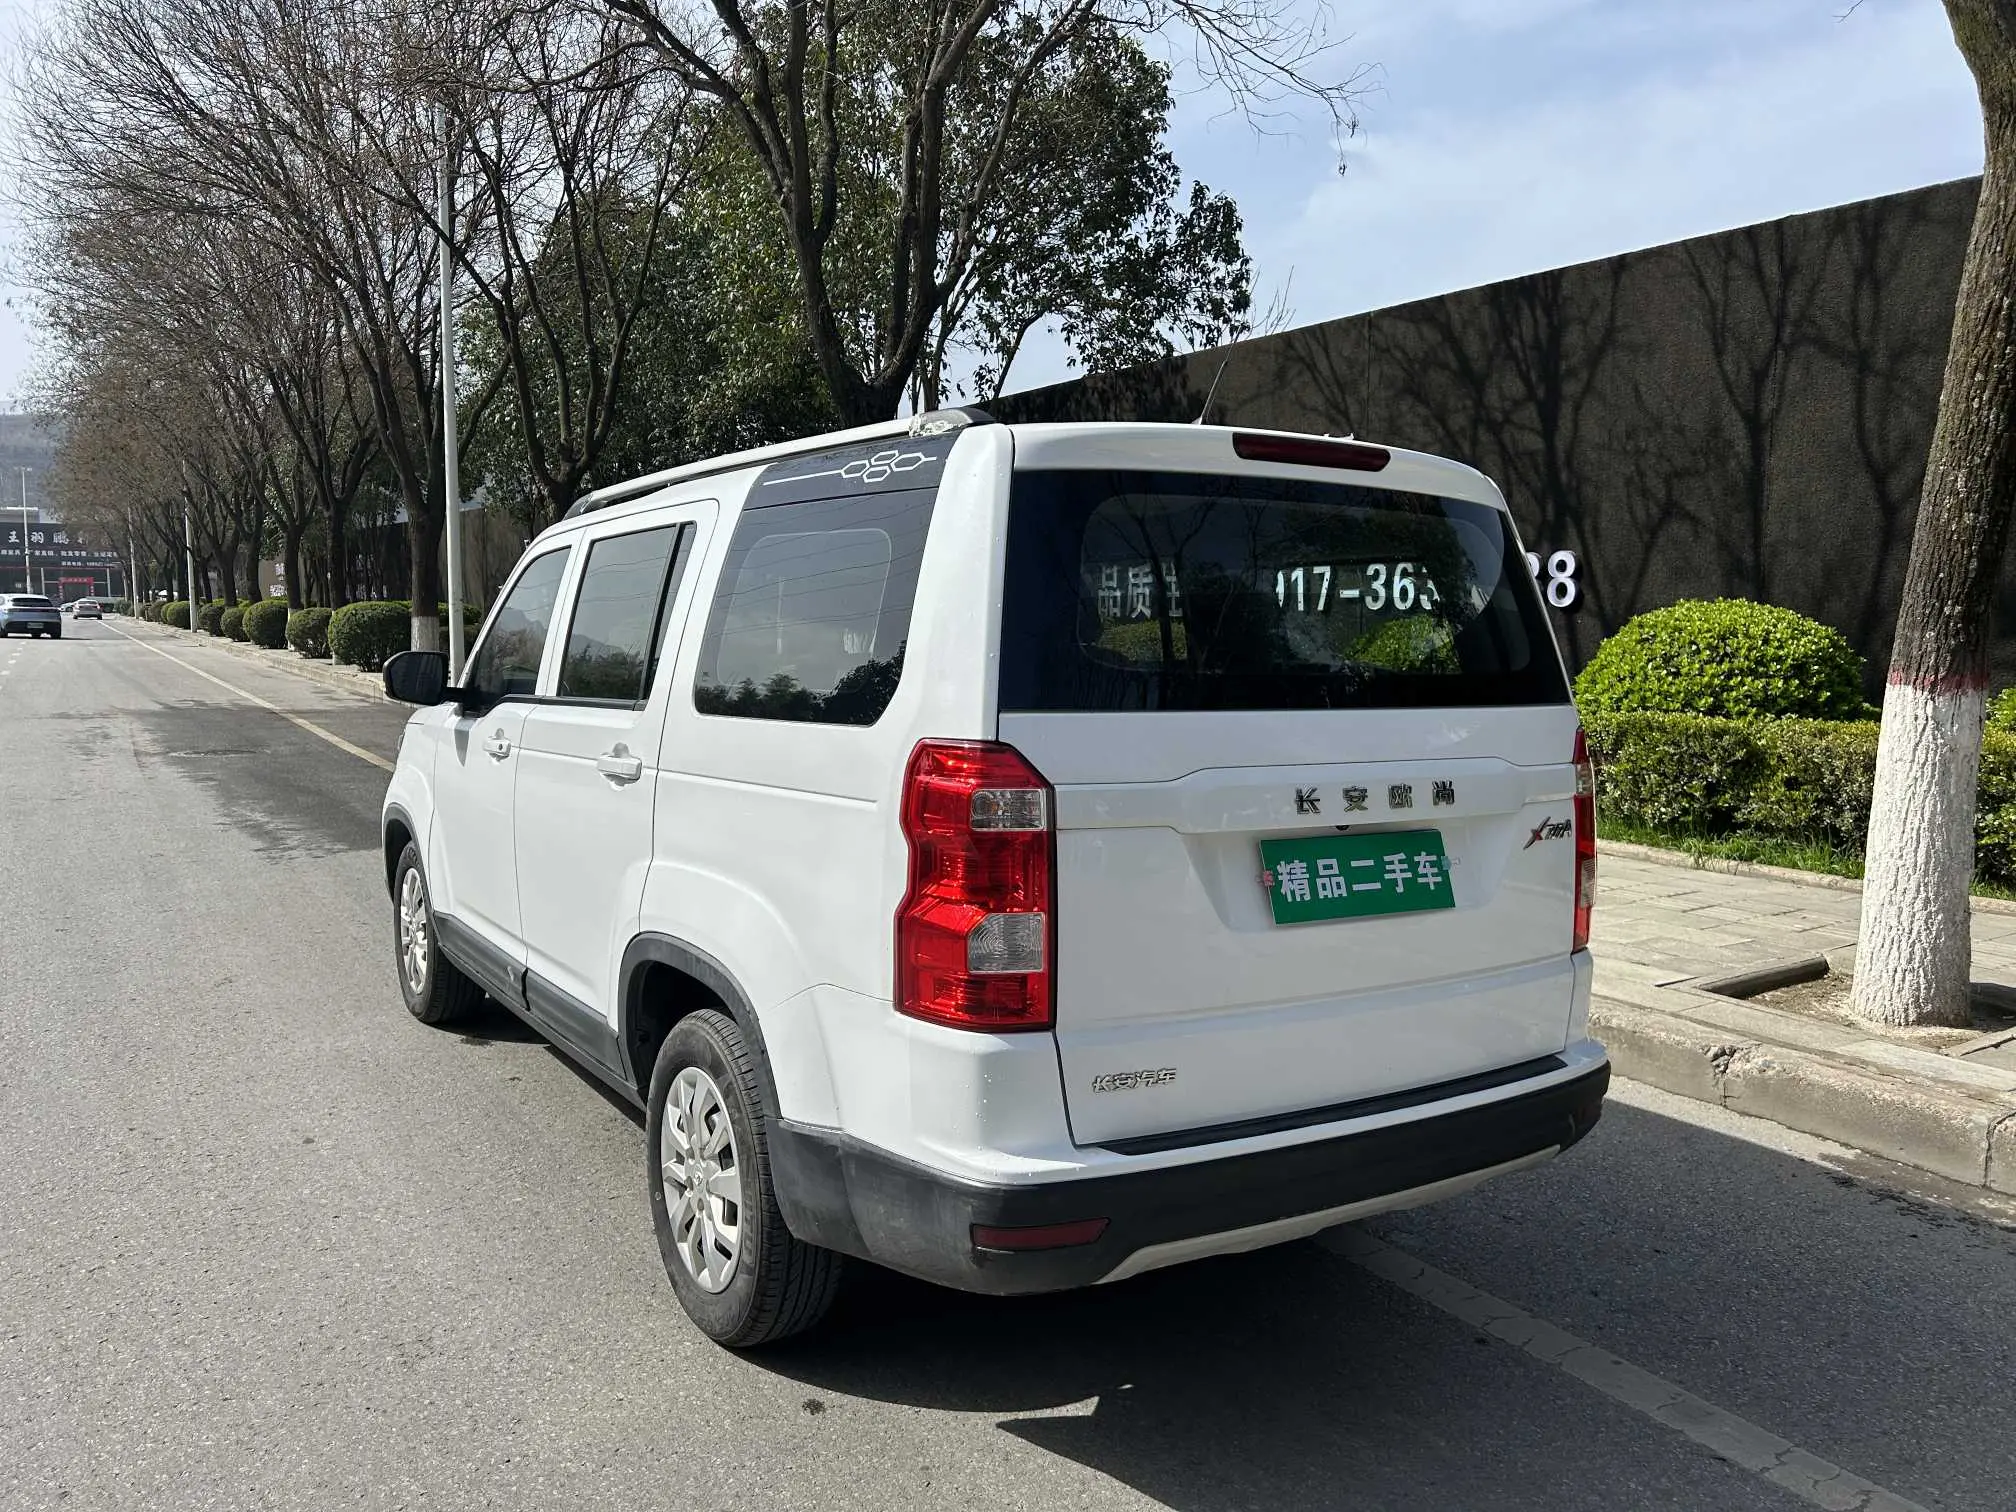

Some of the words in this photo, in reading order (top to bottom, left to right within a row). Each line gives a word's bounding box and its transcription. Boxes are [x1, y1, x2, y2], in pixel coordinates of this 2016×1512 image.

[1294, 779, 1456, 815] 长安欧尚
[1276, 851, 1443, 903] 精品二手车
[1092, 1067, 1177, 1093] 长安汽车
